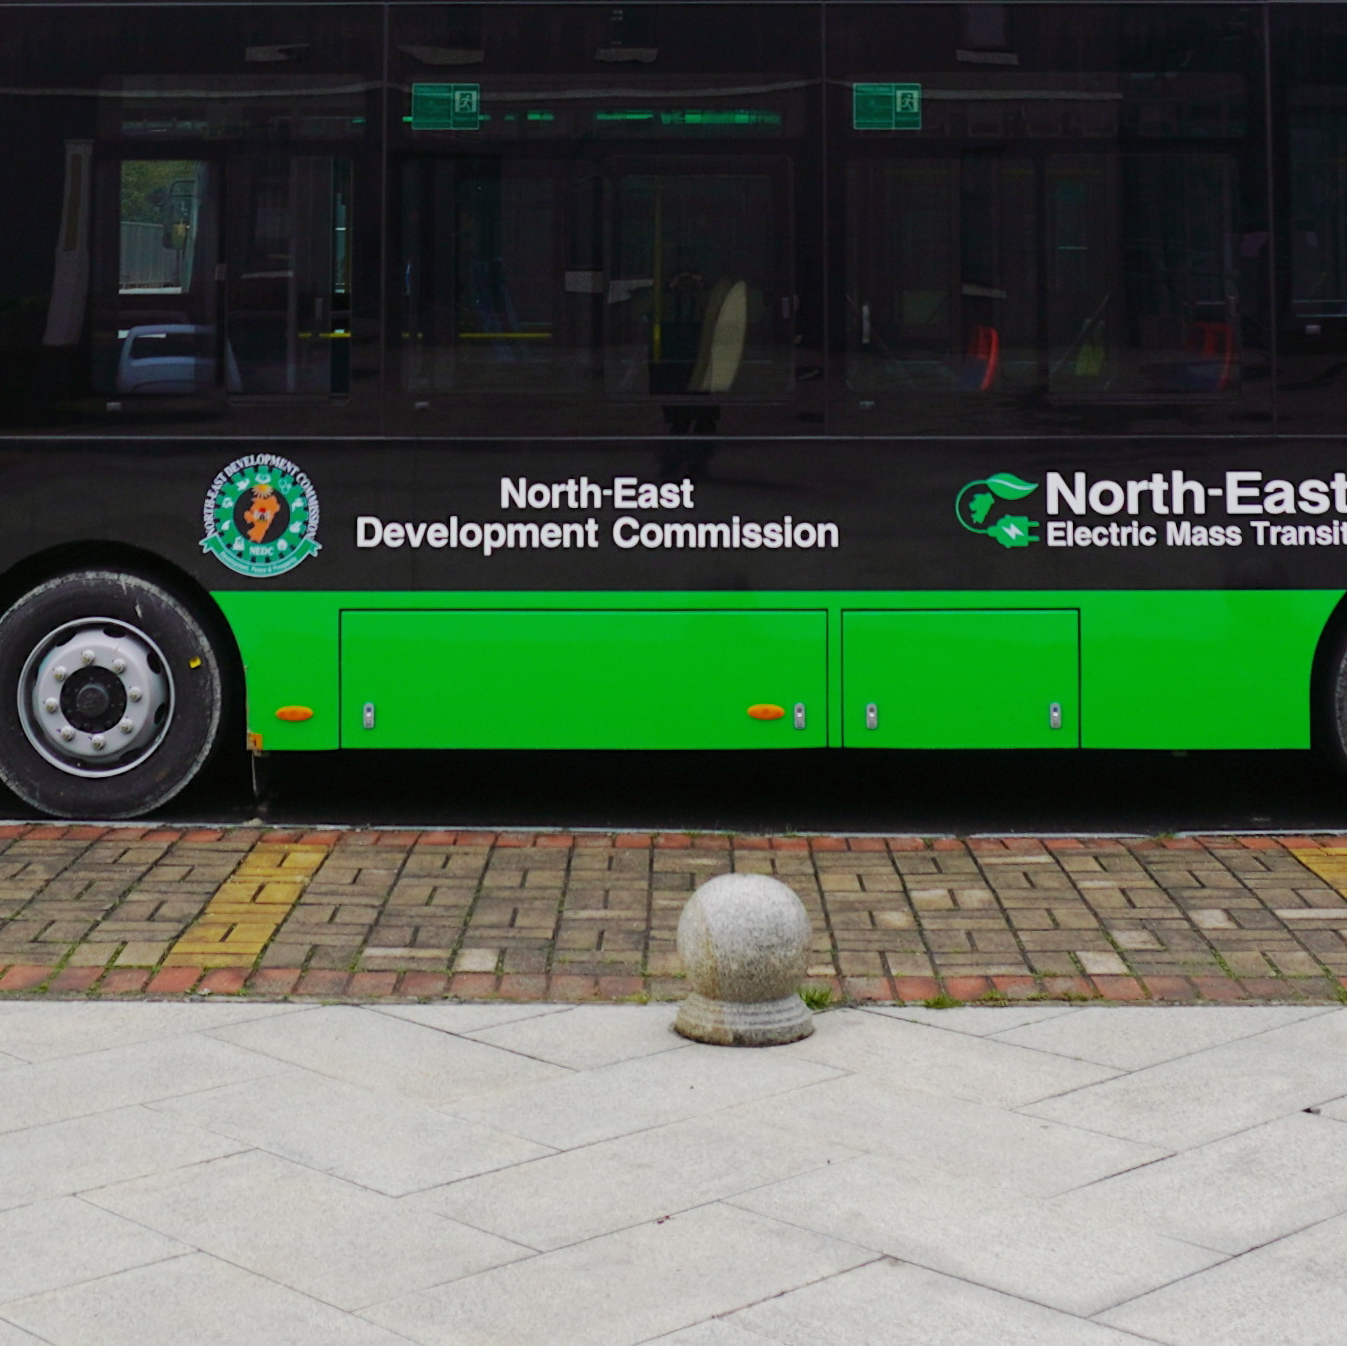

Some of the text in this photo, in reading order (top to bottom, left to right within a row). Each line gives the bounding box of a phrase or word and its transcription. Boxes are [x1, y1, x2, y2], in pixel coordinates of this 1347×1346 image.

[203, 453, 320, 540] NORTH-EAST DEVELOPMENT COMMISSION
[501, 477, 694, 508] North-East
[357, 516, 838, 556] Development Commission
[1047, 521, 1156, 546] Electric
[1167, 521, 1242, 546] Mass
[249, 546, 275, 557] NEDC
